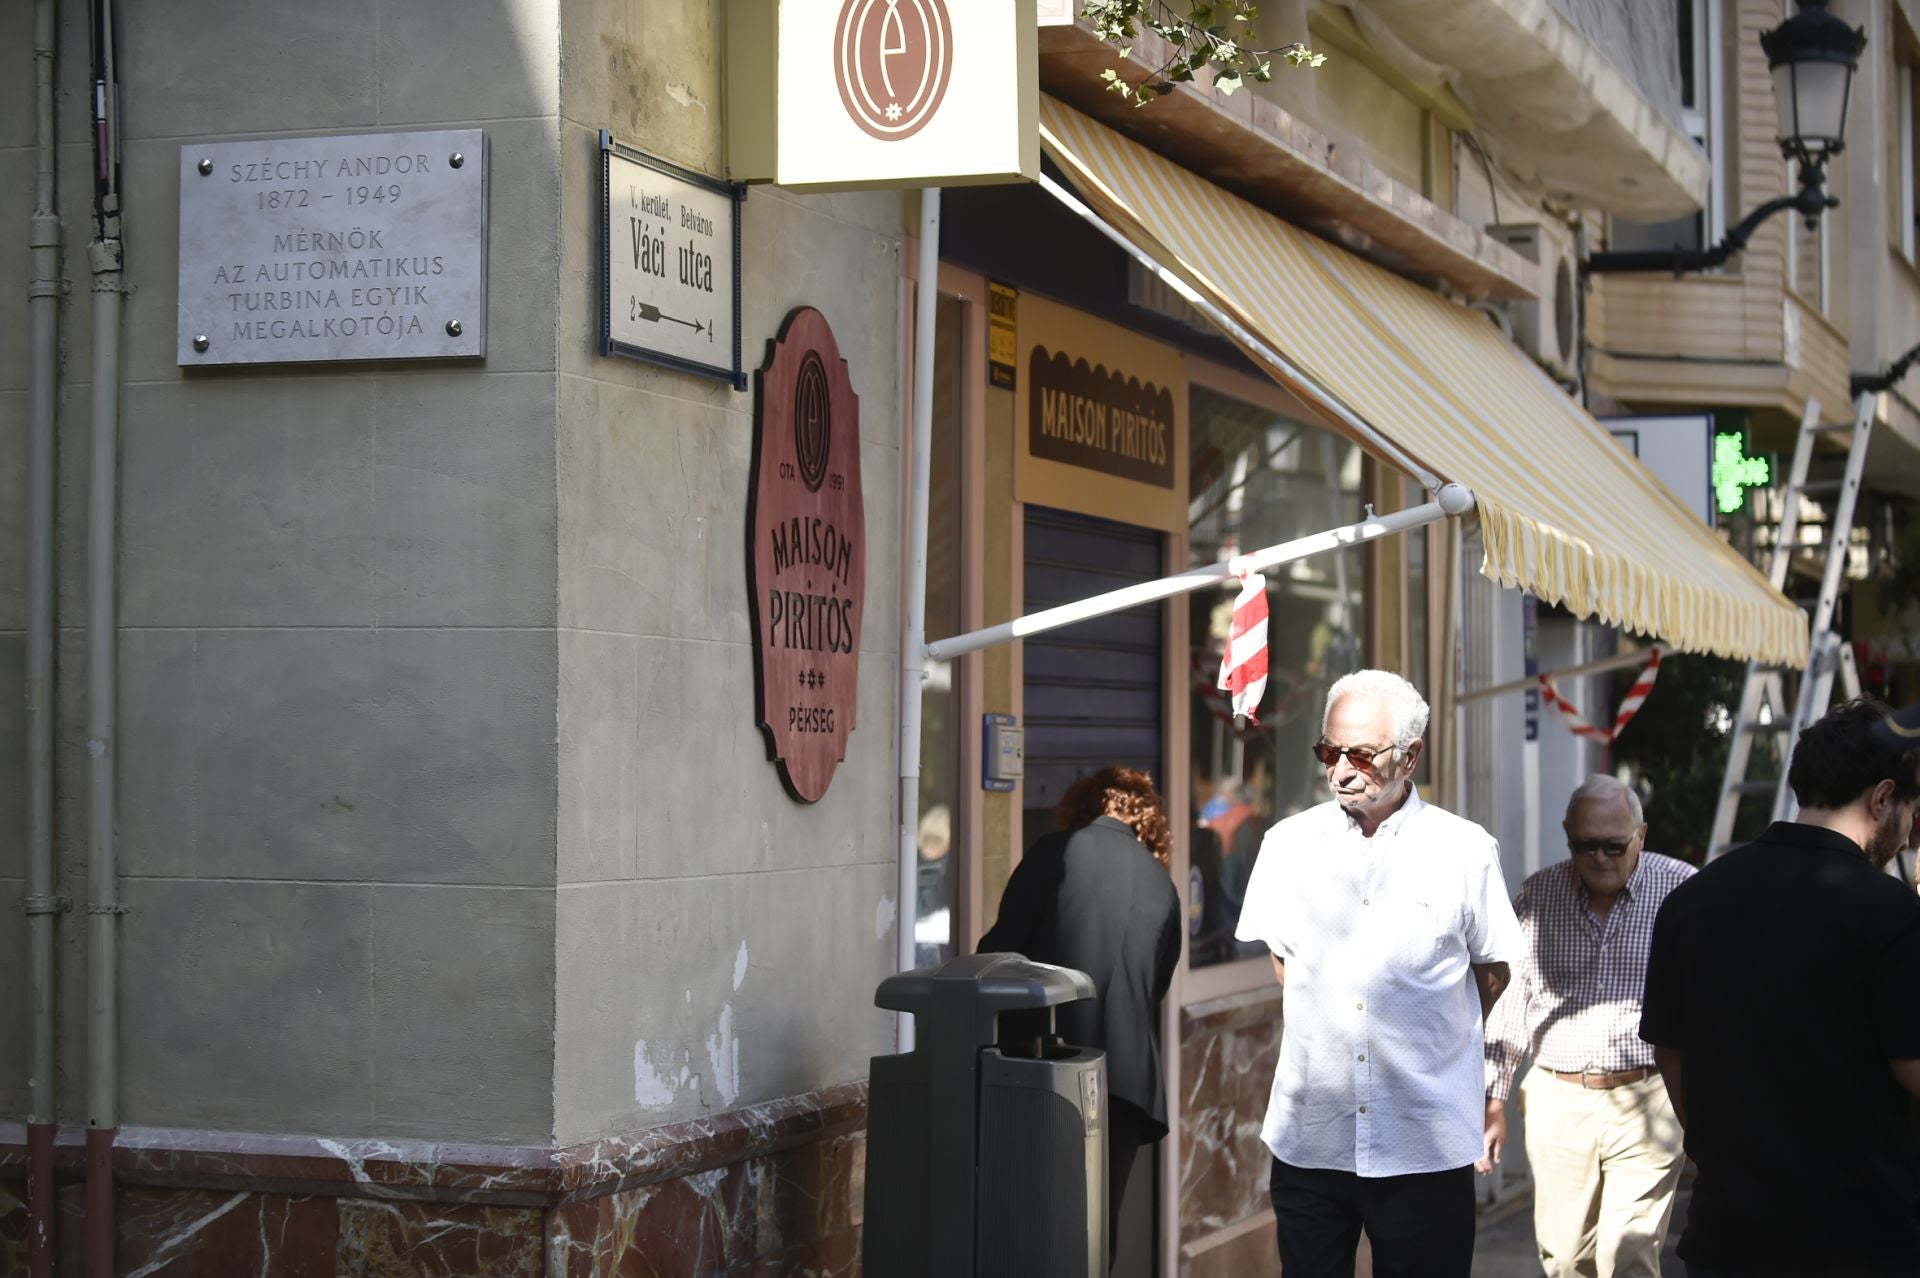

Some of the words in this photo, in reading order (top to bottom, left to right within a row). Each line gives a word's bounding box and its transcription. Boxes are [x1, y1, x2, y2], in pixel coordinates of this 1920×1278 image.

[230, 157, 328, 183] SZÉCHY
[336, 154, 431, 178] ANDOR
[258, 189, 310, 210] 1872
[346, 184, 402, 206] 1949
[630, 185, 638, 208] V.
[641, 189, 672, 223] kerület,
[681, 205, 714, 237] Belváros
[273, 227, 384, 253] MÉRNÖK
[630, 216, 666, 278] Váci
[678, 239, 714, 293] utca
[213, 264, 246, 285] AZ
[255, 256, 444, 282] AUTOMATIKUS
[228, 289, 341, 312] TURBINA
[351, 285, 429, 307] EGYIK
[232, 310, 424, 341] MEGALKOTÓJA
[630, 295, 636, 321] 2
[707, 319, 713, 343] 4
[1042, 386, 1106, 450] MAISON
[771, 516, 852, 585] MAISON
[789, 701, 835, 734] PÉKSÉG
